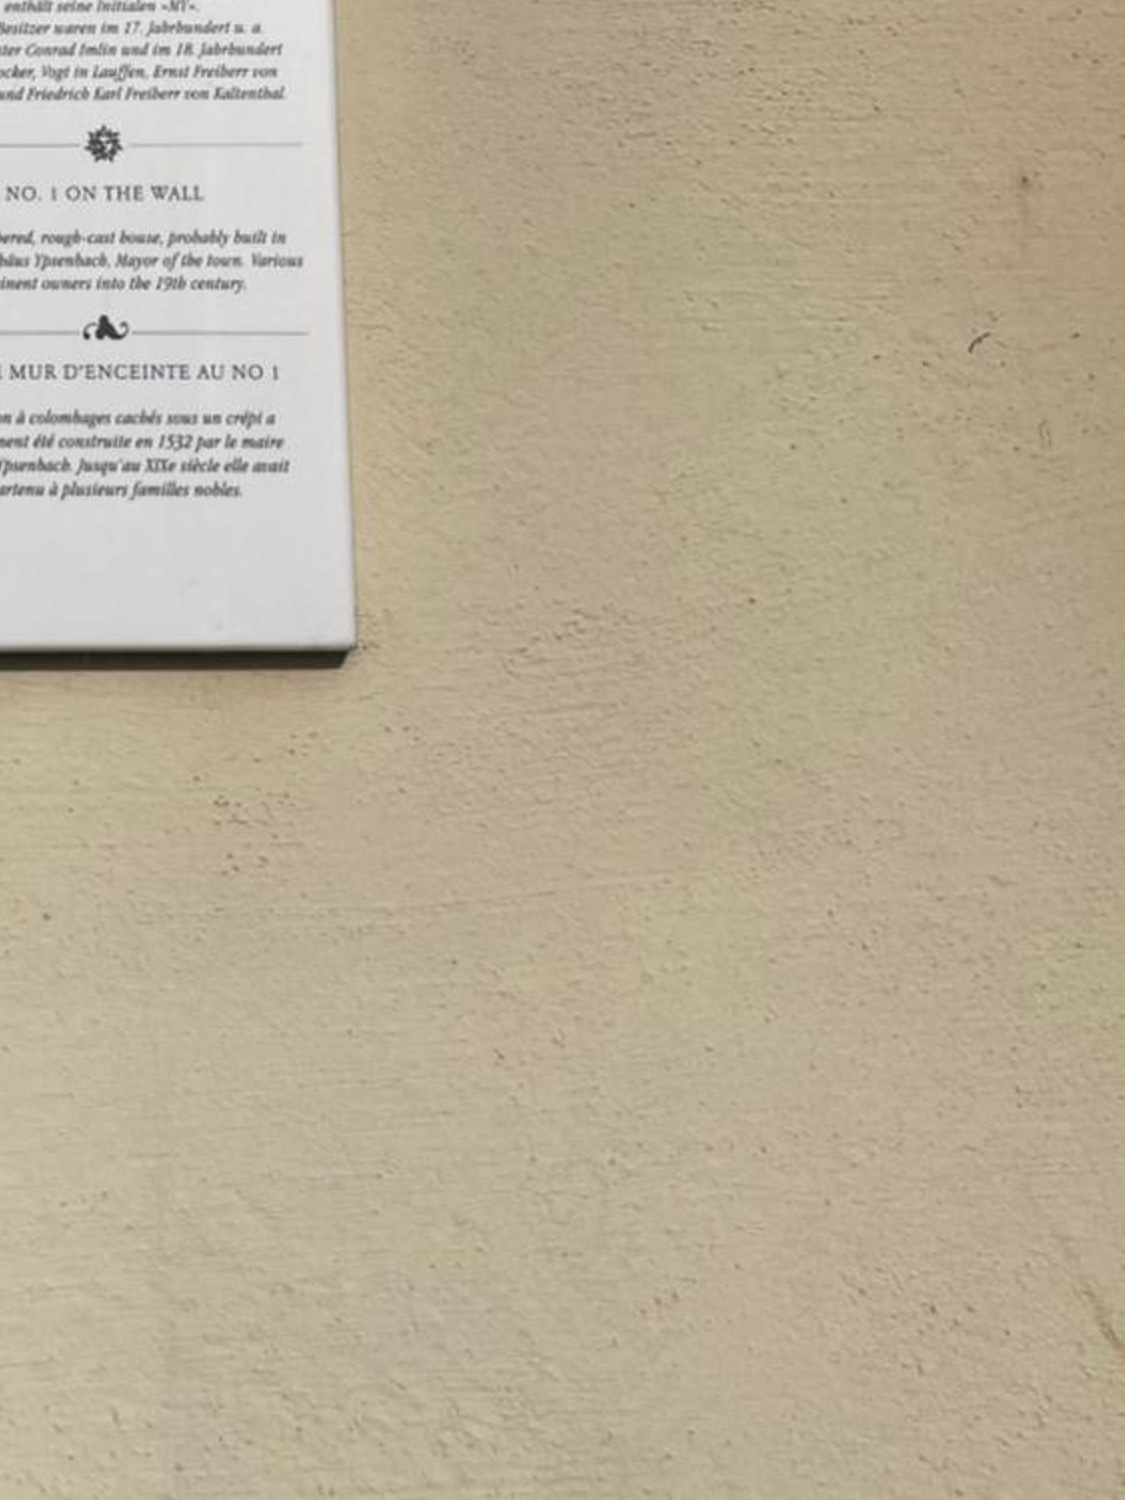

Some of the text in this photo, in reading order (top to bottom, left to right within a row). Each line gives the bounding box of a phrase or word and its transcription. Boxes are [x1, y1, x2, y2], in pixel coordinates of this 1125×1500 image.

[55, 0, 93, 14] seine
[53, 23, 97, 37] waren
[100, 20, 119, 35] im
[124, 20, 144, 36] 17.
[146, 20, 231, 38] Jahrhundert
[24, 41, 76, 58] Conrad
[121, 42, 149, 57] und
[152, 42, 171, 57] im
[197, 41, 283, 60] Jahrhundert
[41, 64, 70, 83] Vogt
[73, 65, 89, 80] in
[153, 64, 190, 79] Ernst
[192, 63, 249, 79] Freiherr
[252, 67, 278, 78] von
[26, 85, 90, 102] Friedrich
[93, 85, 122, 101] Karl
[124, 85, 181, 101] Freiherr
[183, 88, 210, 100] von
[5, 184, 204, 202] NO. 1 ON THE WALL
[40, 229, 116, 249] rough-cast
[119, 229, 164, 247] house,
[166, 228, 231, 249] probably
[233, 228, 268, 245] built
[271, 230, 287, 245] in
[114, 252, 159, 272] Mayor
[161, 250, 179, 273] of
[180, 251, 203, 268] the
[206, 253, 244, 269] town.
[251, 252, 304, 269] Various
[40, 279, 92, 291] owners
[95, 276, 126, 292] into
[129, 274, 152, 291] the
[155, 274, 187, 292] 19th
[190, 277, 247, 295] century.
[9, 363, 57, 381] MUR
[196, 364, 225, 381] AU
[231, 364, 264, 381] NO
[272, 364, 279, 381] 1
[15, 409, 26, 426] à
[28, 408, 112, 430] colombages
[114, 408, 163, 426] cachés
[165, 413, 199, 426] sous
[202, 413, 222, 425] un
[225, 410, 263, 430] crépi
[265, 414, 276, 426] a
[32, 433, 55, 449] été
[57, 434, 133, 449] construite
[135, 437, 154, 449] en
[158, 433, 193, 452] 1532
[194, 435, 222, 454] par
[224, 433, 238, 449] le
[241, 435, 285, 450] maire
[144, 457, 177, 474] XIXe
[179, 457, 221, 474] siècle
[223, 456, 248, 474] elle
[249, 458, 290, 474] avait
[48, 481, 59, 497] à
[61, 480, 128, 501] plusieurs
[130, 480, 191, 501] familles
[193, 480, 243, 498] nobles.
